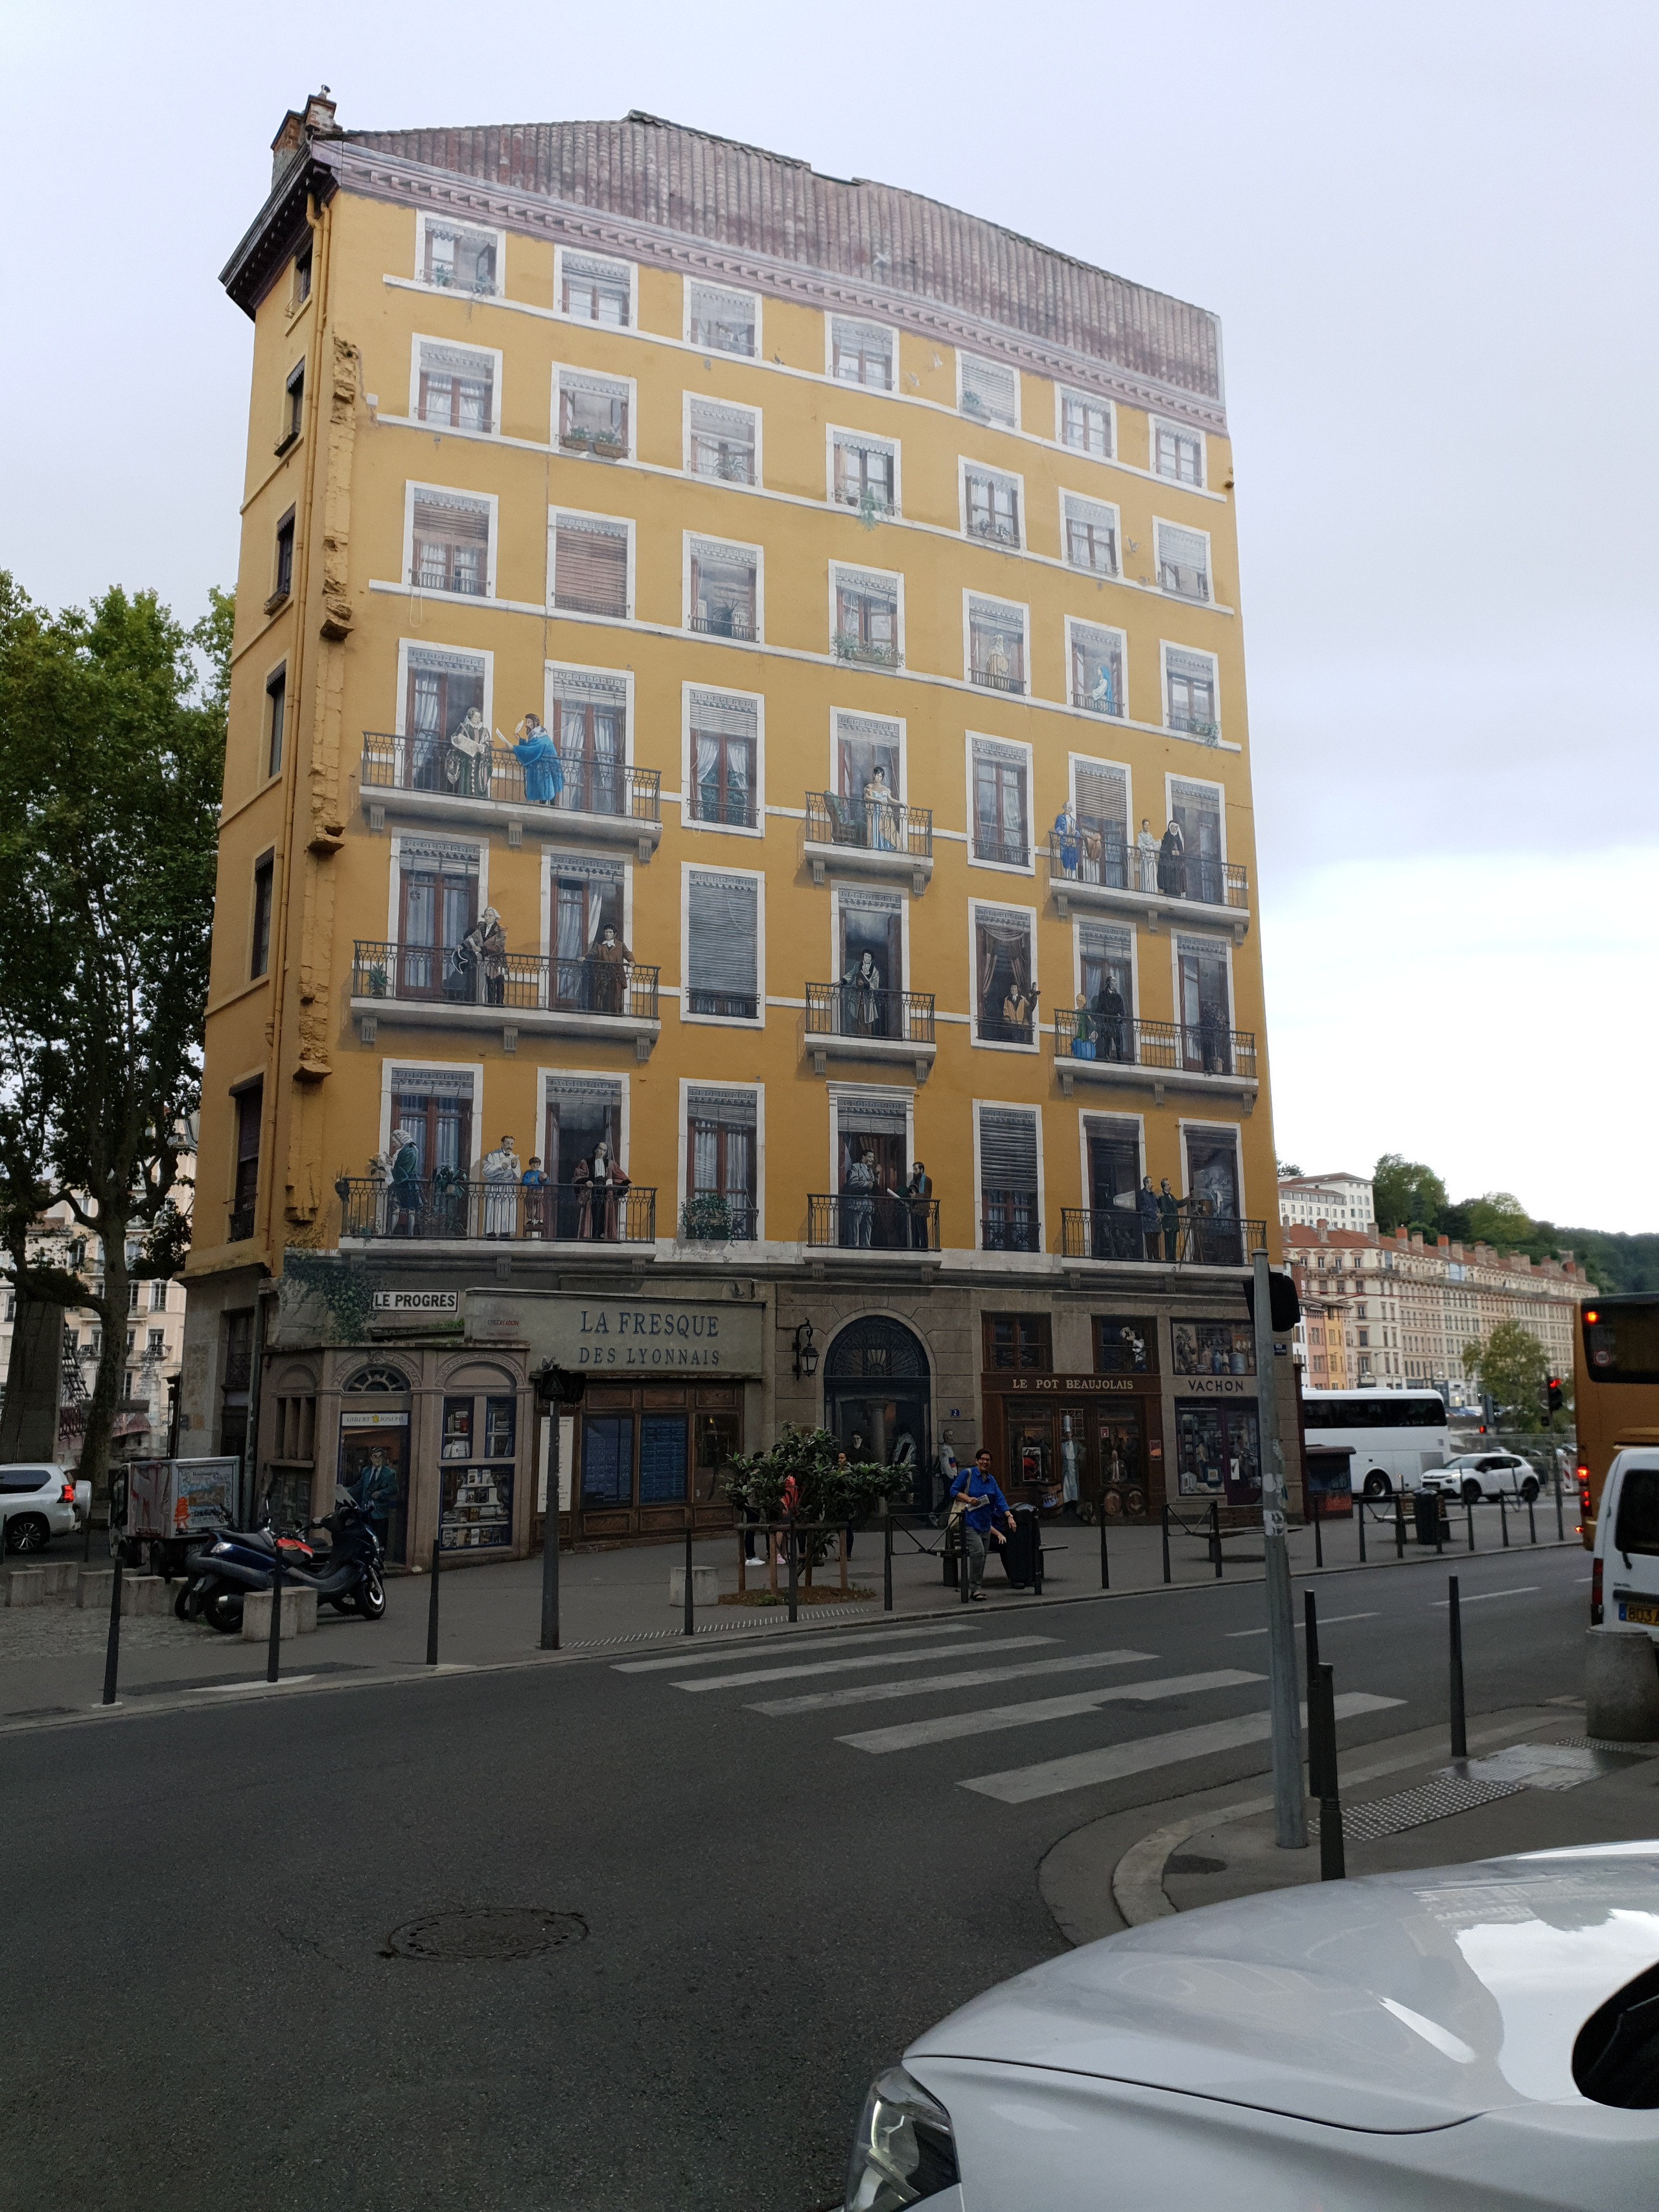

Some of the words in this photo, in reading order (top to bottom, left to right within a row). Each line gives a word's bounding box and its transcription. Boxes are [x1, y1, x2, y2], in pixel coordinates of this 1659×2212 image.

[375, 1294, 390, 1307] LE
[580, 1310, 609, 1334] LA
[618, 1312, 719, 1339] FRESQUE
[578, 1347, 616, 1364] DES
[626, 1348, 720, 1366] LYONNAIS
[1012, 1379, 1028, 1389] LE
[1036, 1379, 1060, 1389] POT
[1066, 1379, 1134, 1390] BEAUJOLAIS
[1188, 1380, 1244, 1391] VACHON
